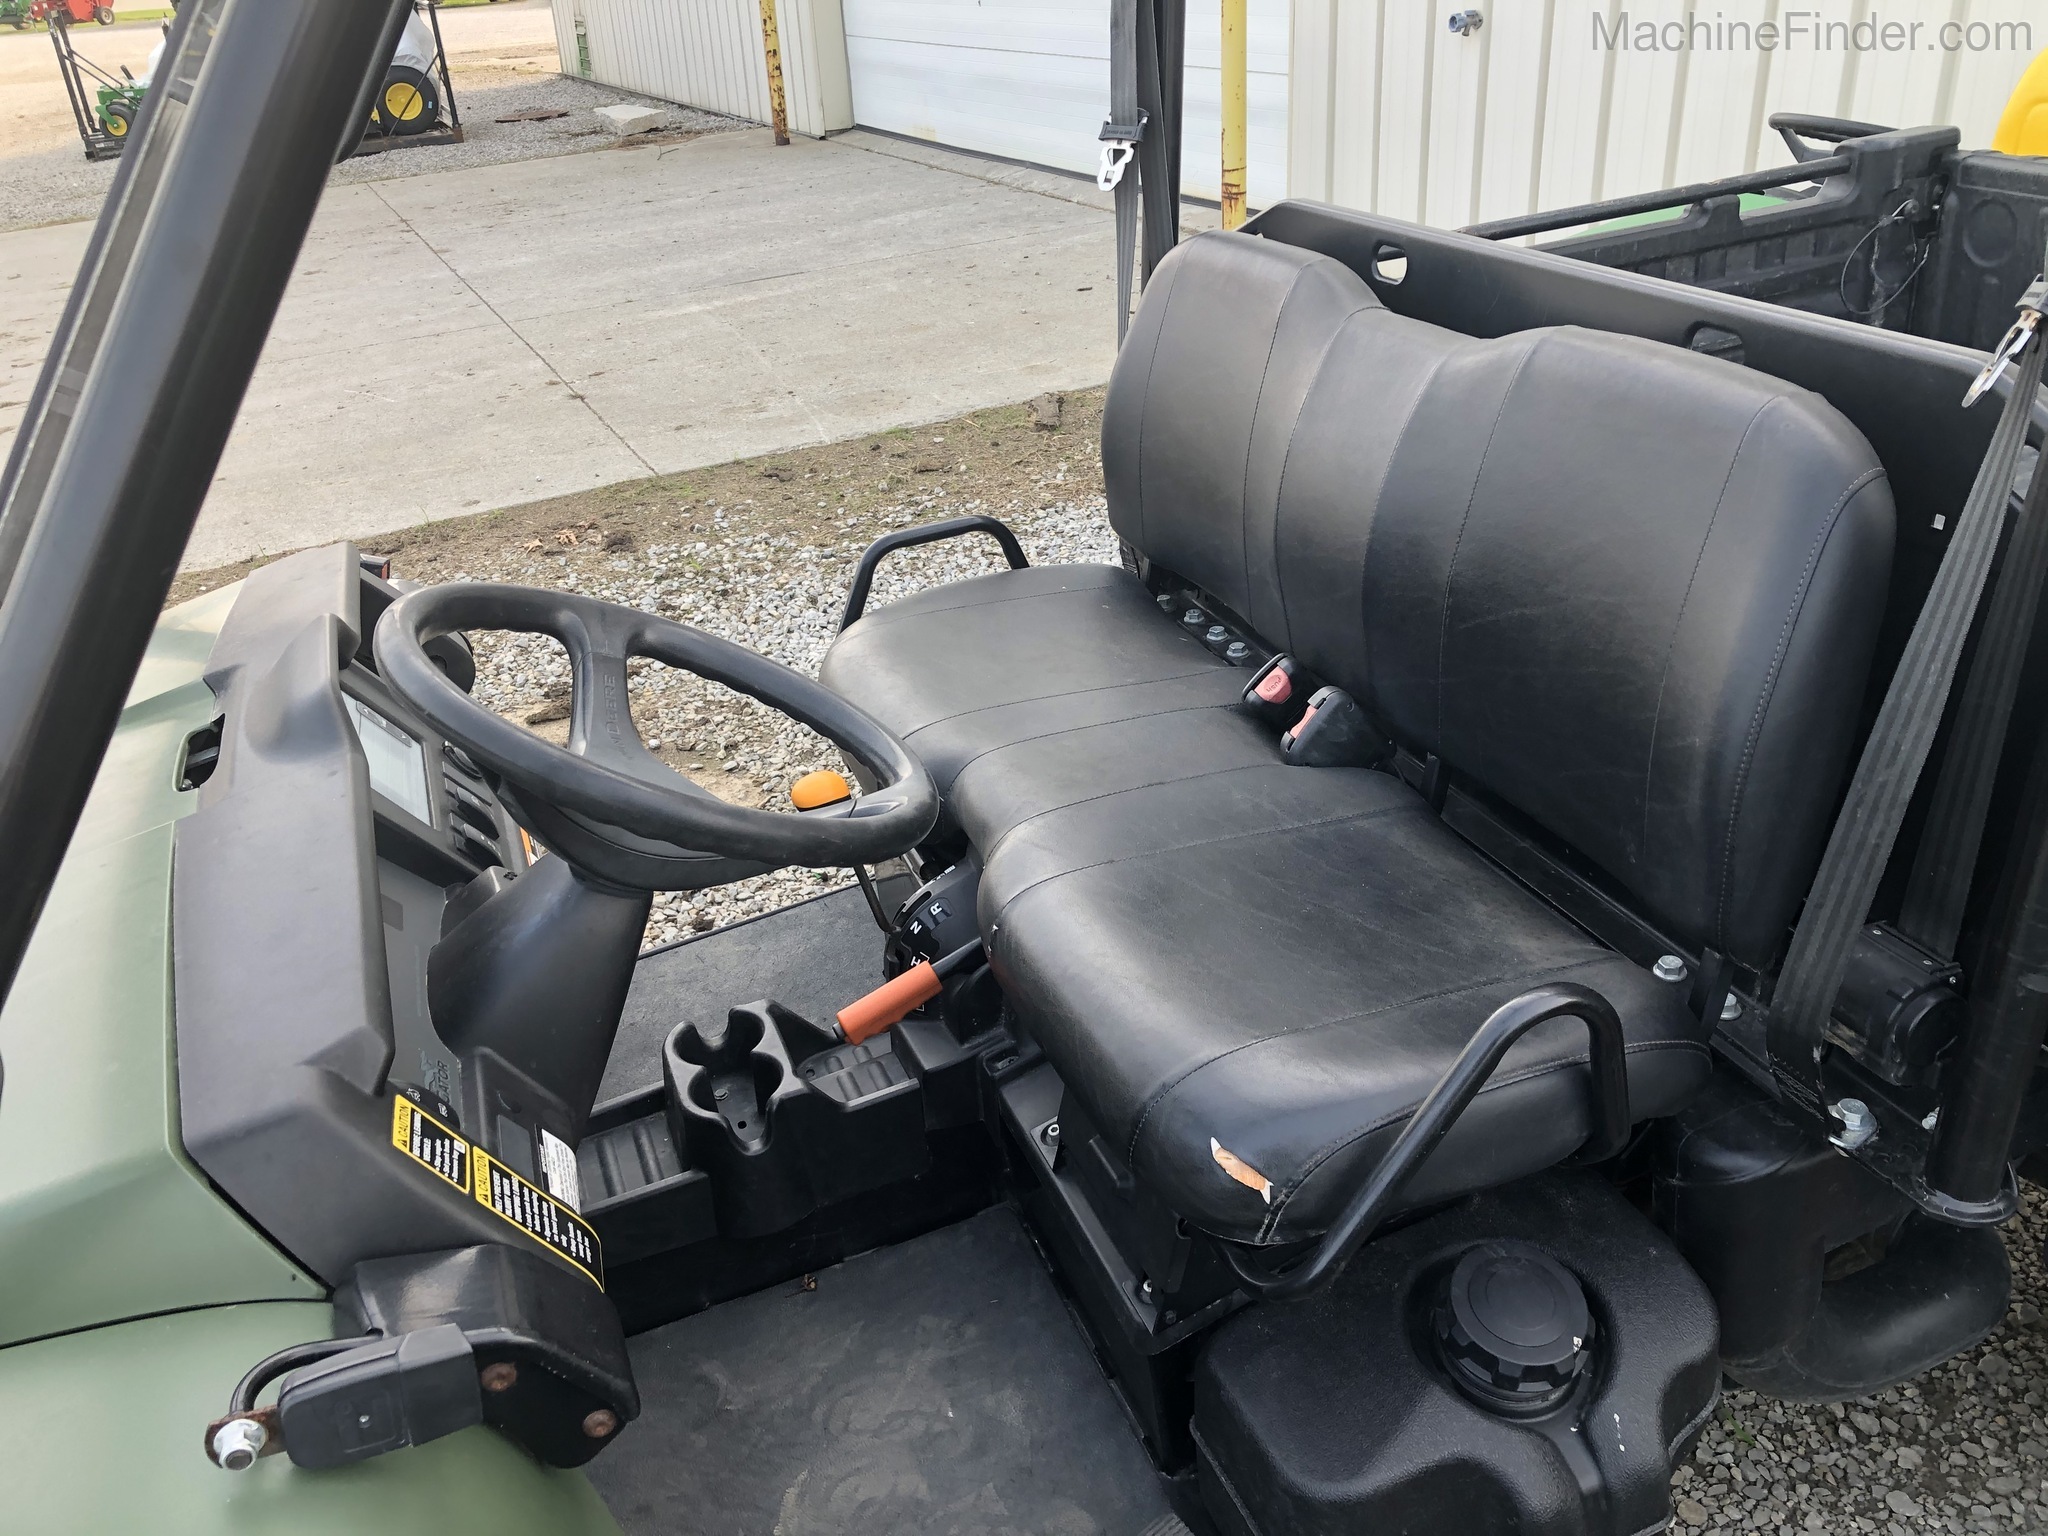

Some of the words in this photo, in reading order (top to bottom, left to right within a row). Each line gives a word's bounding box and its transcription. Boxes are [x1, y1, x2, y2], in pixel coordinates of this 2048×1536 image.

[604, 675, 620, 736] DEERE
[930, 902, 942, 916] R
[910, 921, 922, 934] N
[397, 1104, 409, 1138] CAUTION
[476, 1153, 489, 1192] CAUTION
